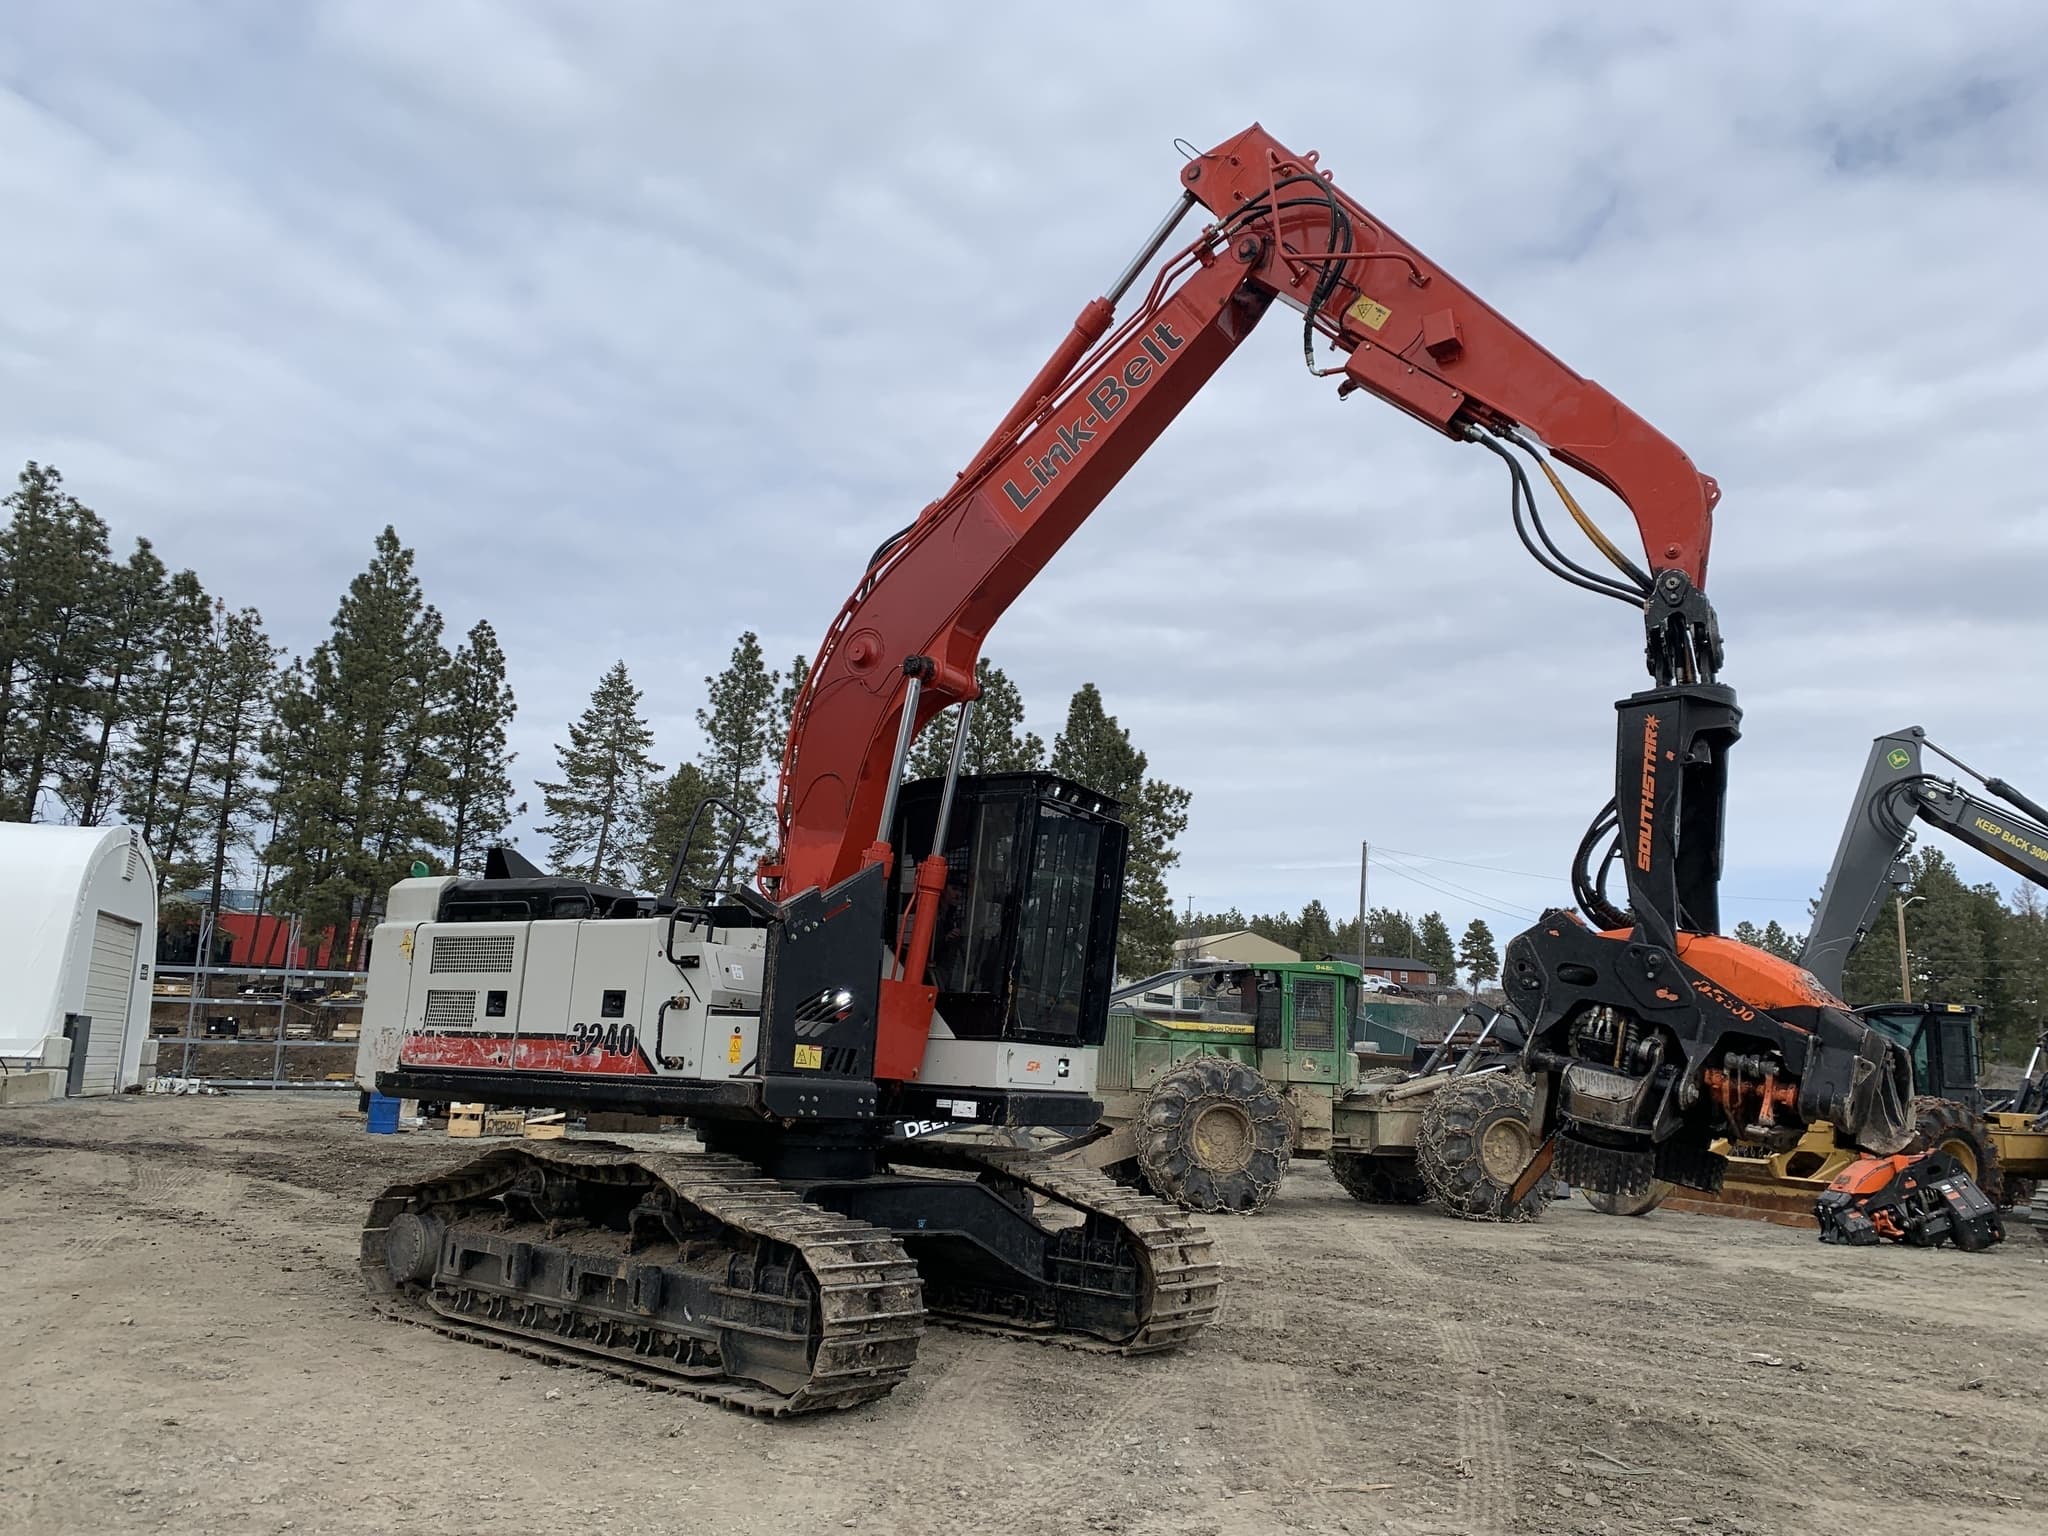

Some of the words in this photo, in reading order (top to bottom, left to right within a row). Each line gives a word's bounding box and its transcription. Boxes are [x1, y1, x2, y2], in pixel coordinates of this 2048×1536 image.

[1002, 321, 1185, 512] Link-Belt
[1637, 725, 1658, 873] SOUTHSTAR
[1975, 816, 2002, 836] KEEP
[2001, 830, 2031, 852] BACK
[571, 1023, 635, 1057] 3240
